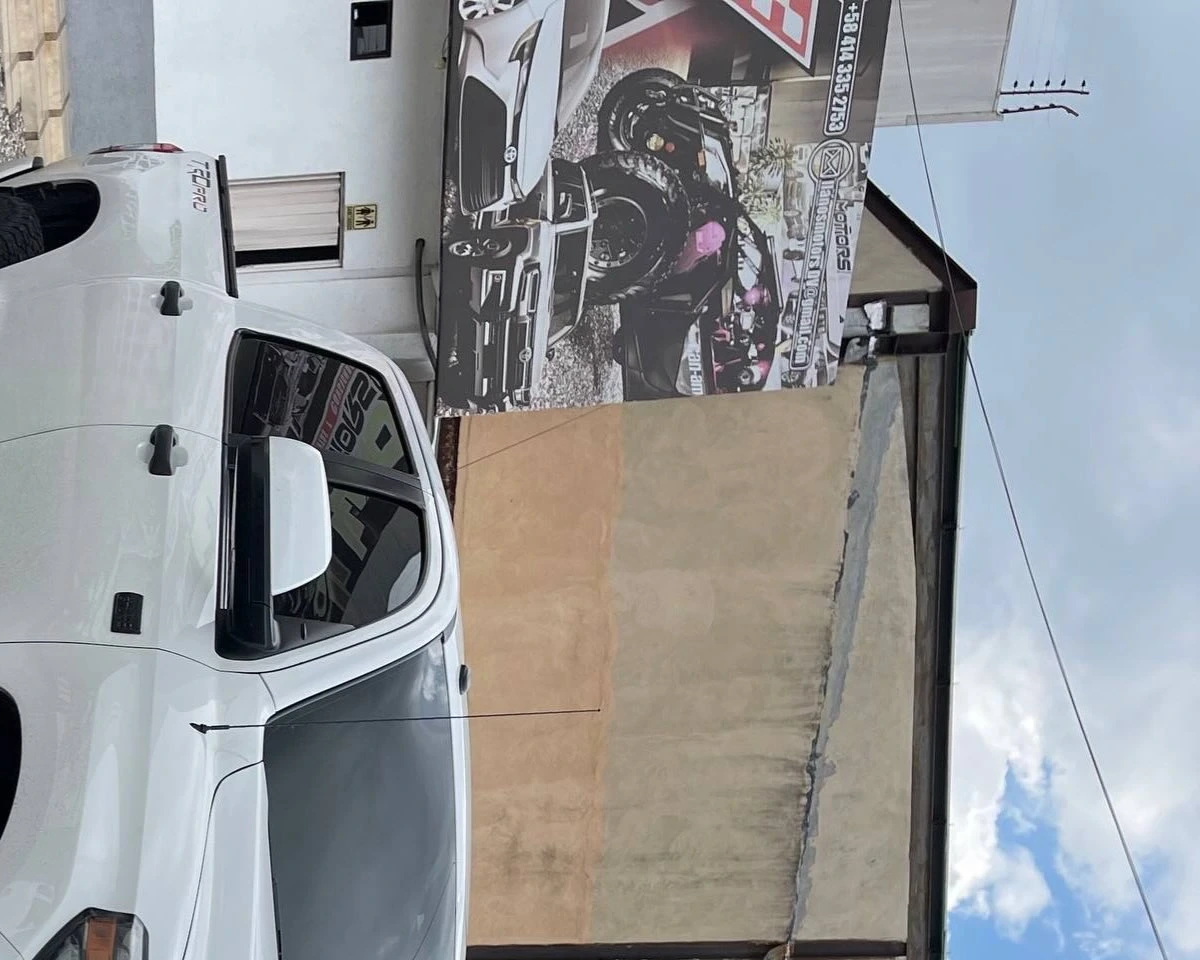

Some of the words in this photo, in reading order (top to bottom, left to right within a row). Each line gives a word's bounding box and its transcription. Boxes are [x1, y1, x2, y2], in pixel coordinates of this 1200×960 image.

[842, 2, 860, 33] +58
[838, 36, 857, 62] 414
[834, 64, 853, 93] 335
[828, 95, 848, 132] 2753
[833, 200, 853, 271] MOTORS
[687, 345, 704, 395] an-am
